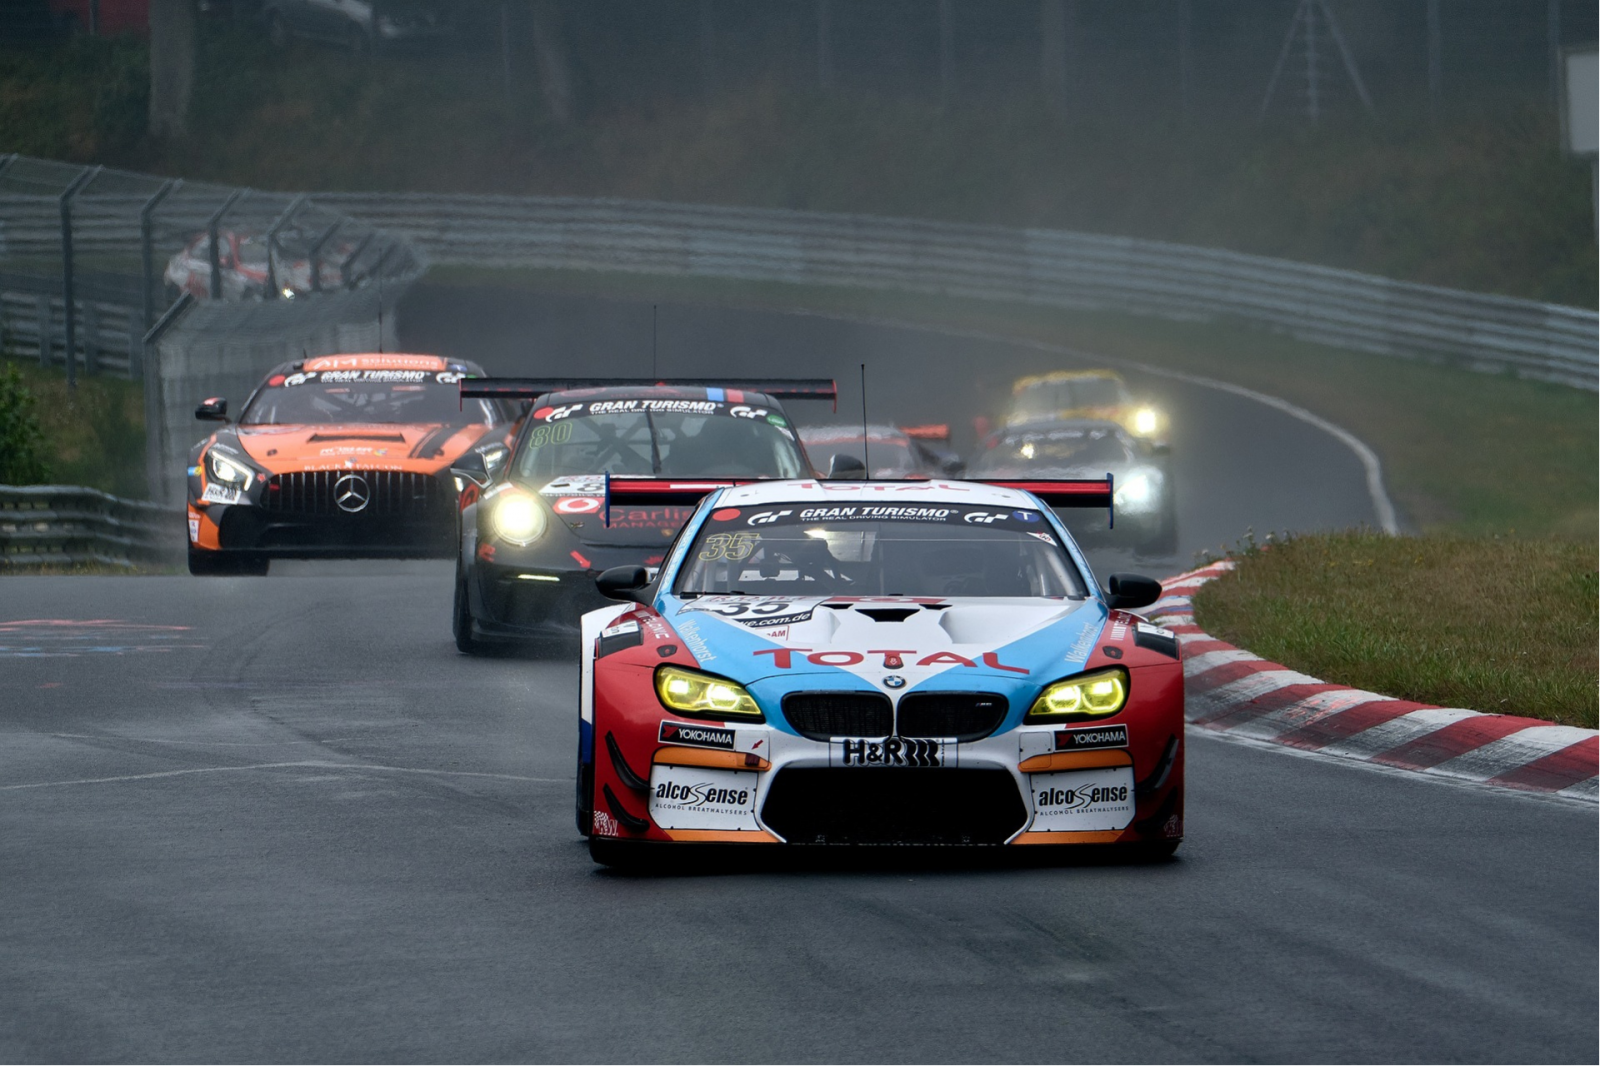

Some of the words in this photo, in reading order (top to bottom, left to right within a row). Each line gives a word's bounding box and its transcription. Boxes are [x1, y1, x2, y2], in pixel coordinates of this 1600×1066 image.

[321, 370, 361, 379] GRAN
[589, 400, 638, 412] GRAN
[642, 400, 716, 411] TURISMO
[800, 507, 856, 518] GRAN
[861, 506, 950, 518] TURISMO
[698, 532, 760, 561] 35
[752, 647, 1030, 675] TOTAL
[678, 727, 733, 745] YOKOHAMA
[1072, 730, 1127, 745] YOKOHAMA
[655, 803, 685, 811] ALCOHOL
[688, 806, 748, 816] BREATHALYSERS
[1076, 806, 1129, 814] BREATHALYSERS
